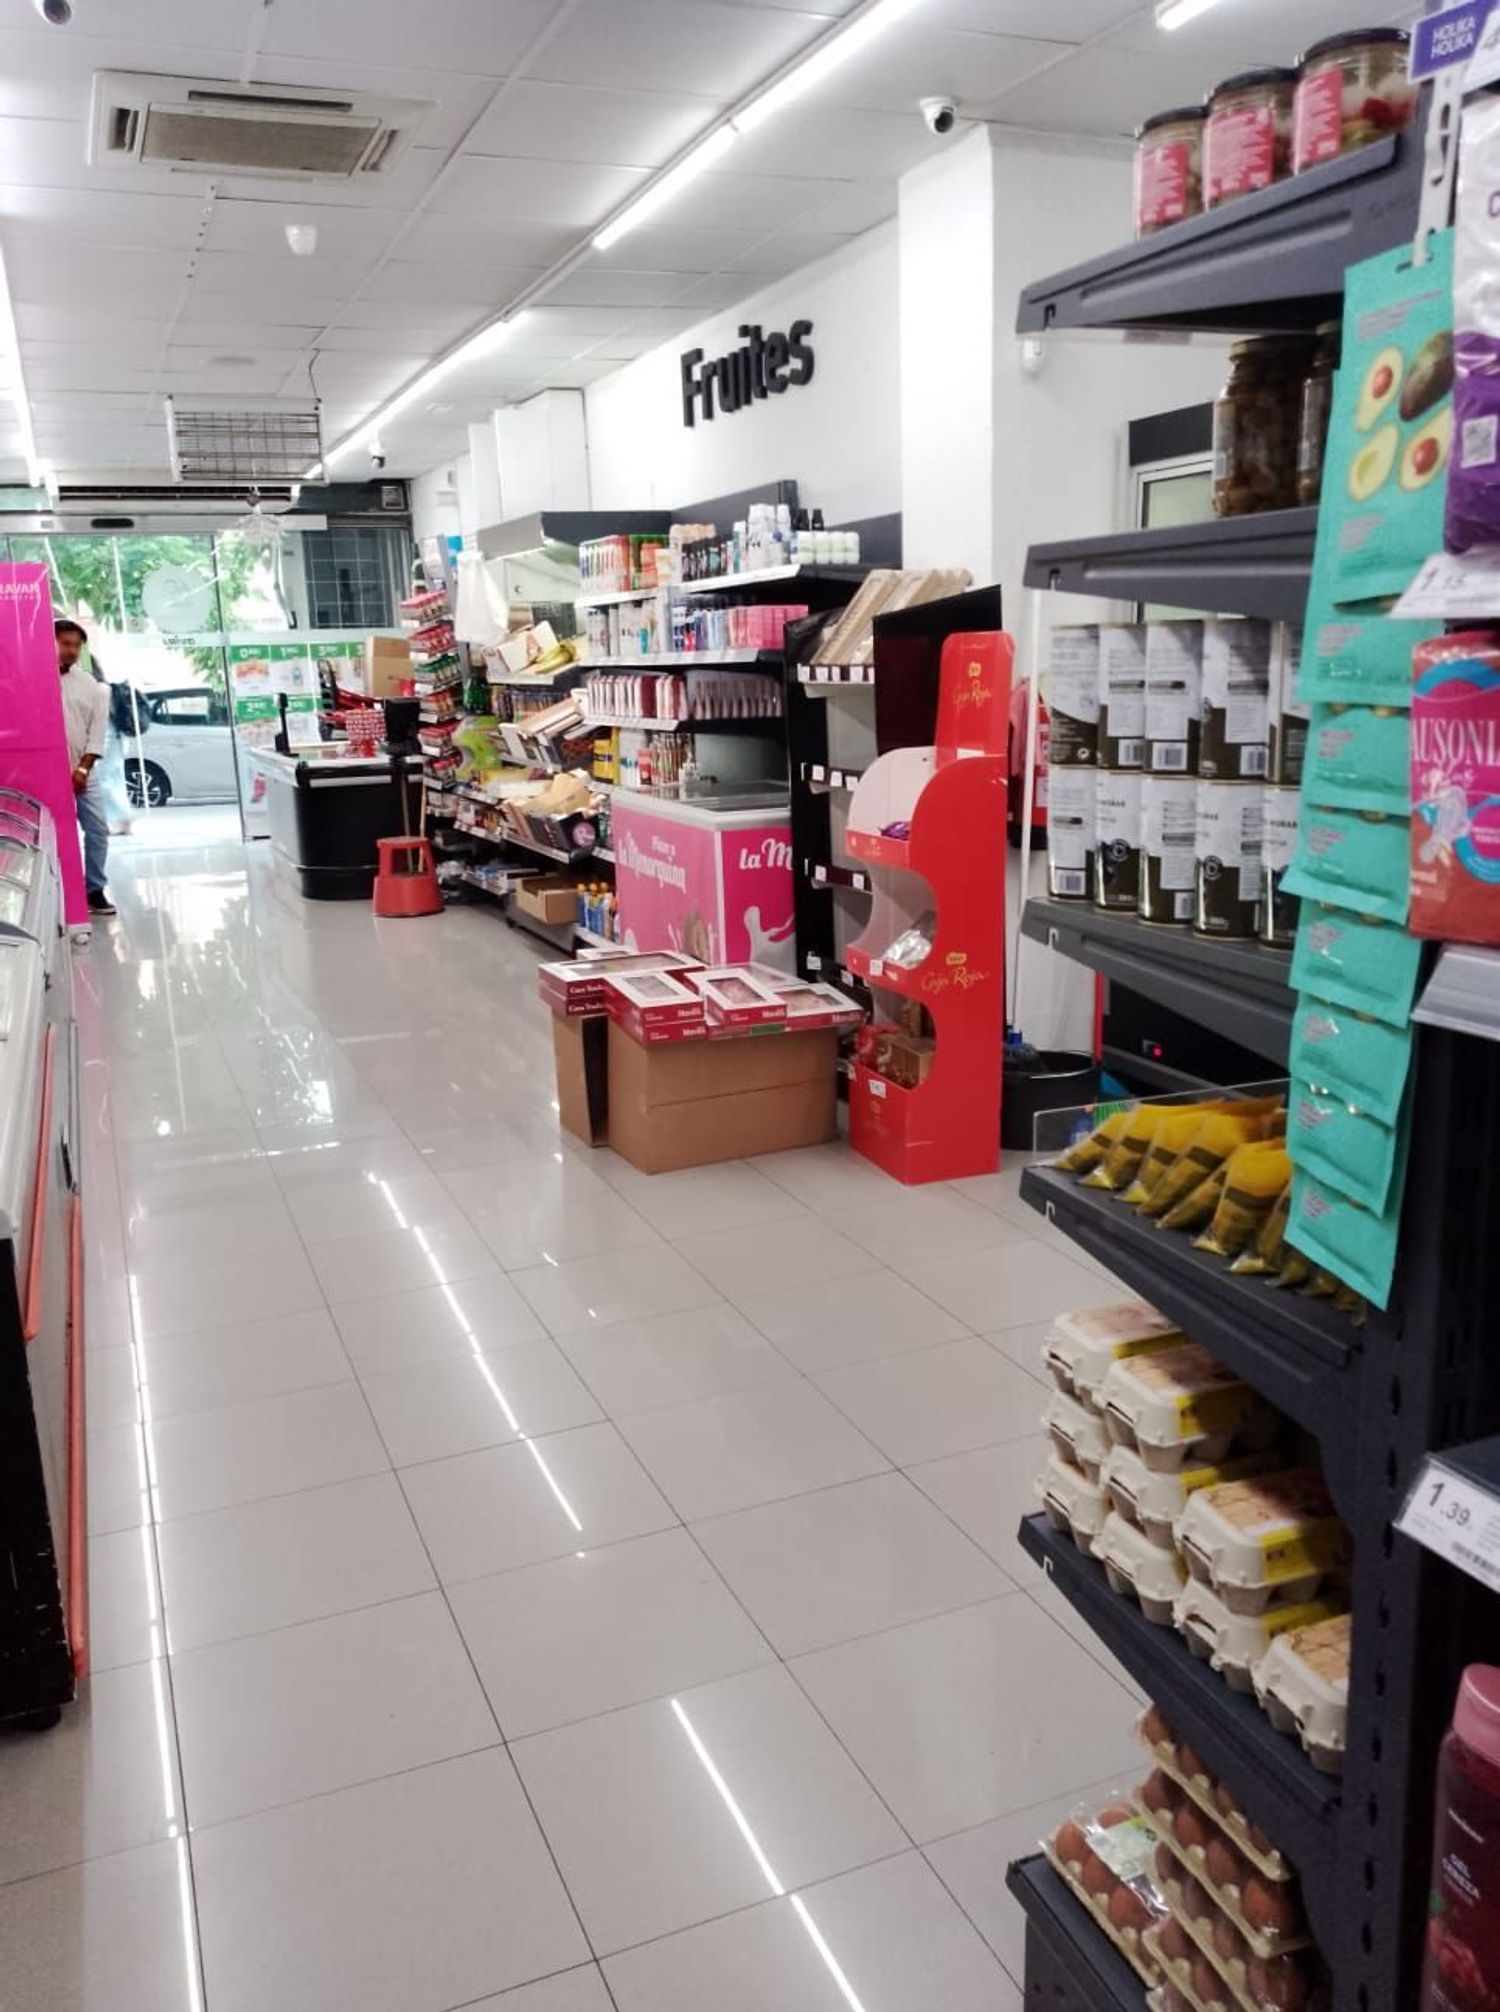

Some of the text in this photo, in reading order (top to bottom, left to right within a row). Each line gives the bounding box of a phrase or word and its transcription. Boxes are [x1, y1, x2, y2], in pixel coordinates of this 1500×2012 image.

[681, 320, 814, 428] Fruites
[1412, 717, 1500, 766] AUSONI
[739, 849, 762, 870] la
